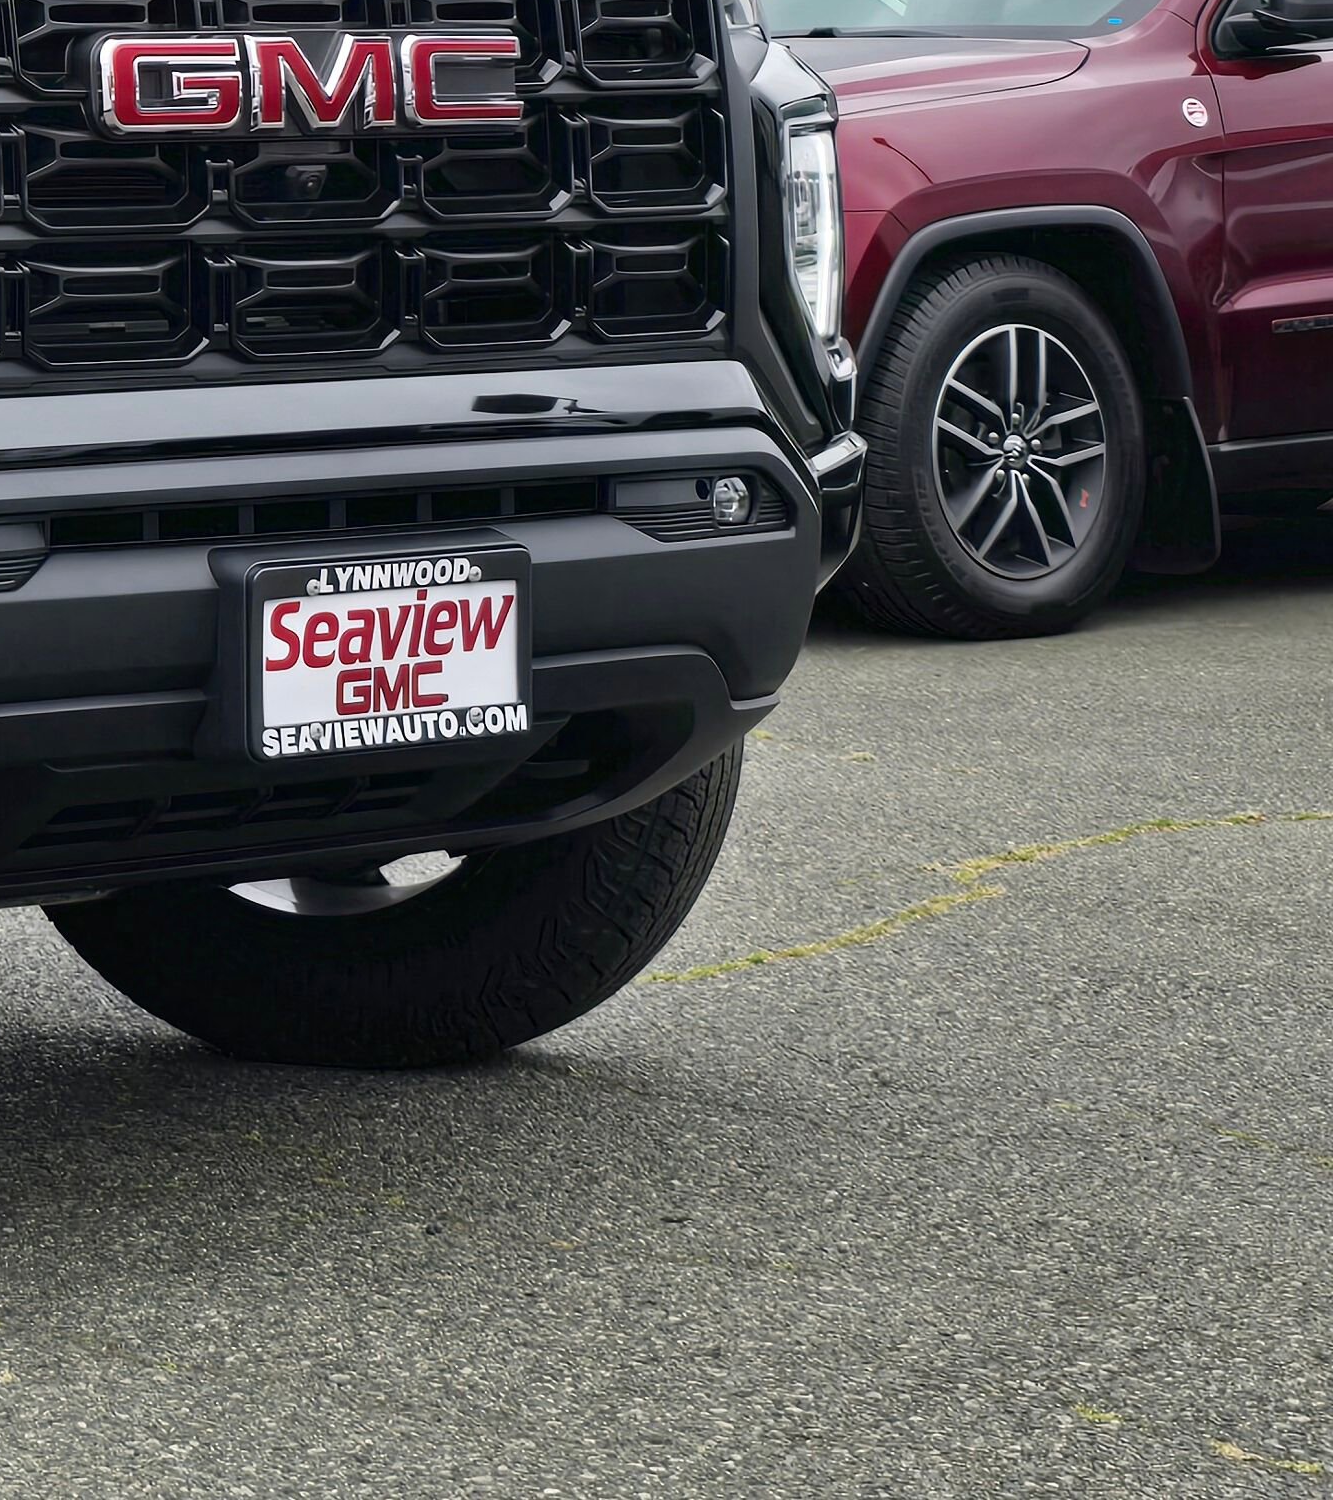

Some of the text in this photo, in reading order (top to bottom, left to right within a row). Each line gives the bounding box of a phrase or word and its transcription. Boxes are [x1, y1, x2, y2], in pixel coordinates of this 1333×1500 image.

[100, 33, 525, 134] GMC
[319, 558, 471, 594] LYNNWOOD
[264, 589, 515, 672] Seaview
[335, 660, 449, 716] GMC
[262, 704, 528, 758] SEAVIEWAUTO.COM
